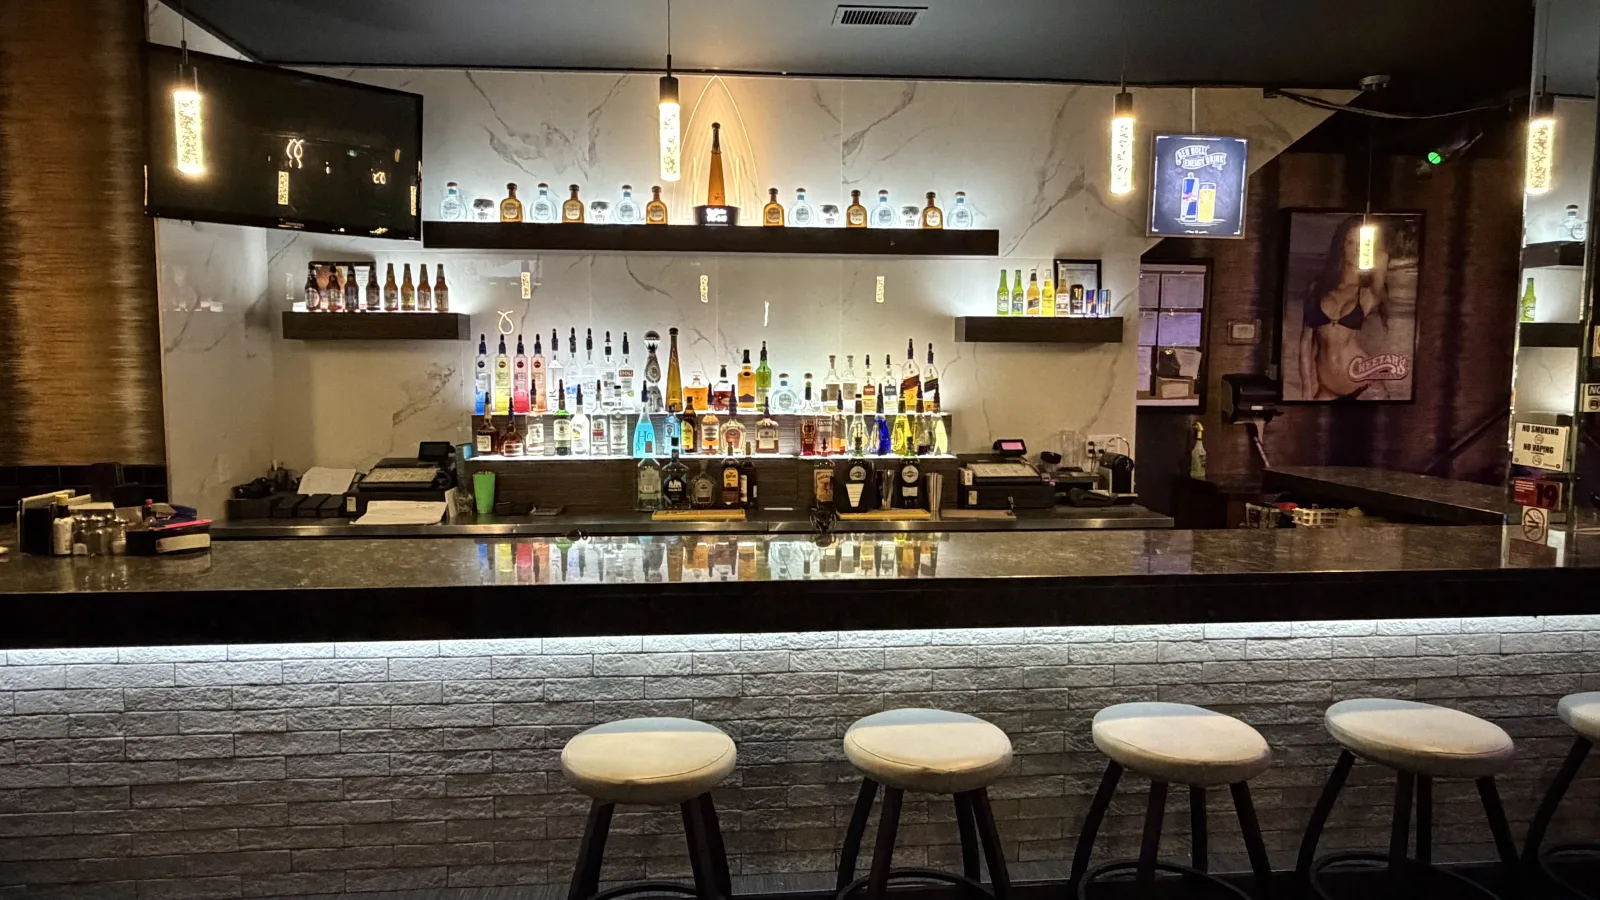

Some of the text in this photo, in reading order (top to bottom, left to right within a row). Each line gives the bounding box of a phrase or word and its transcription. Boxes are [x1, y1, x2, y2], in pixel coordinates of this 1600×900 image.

[1190, 146, 1207, 156] BULL
[1205, 154, 1225, 165] DRINK
[1522, 424, 1559, 436] NO SMOKING
[1523, 443, 1554, 454] NO VAPING
